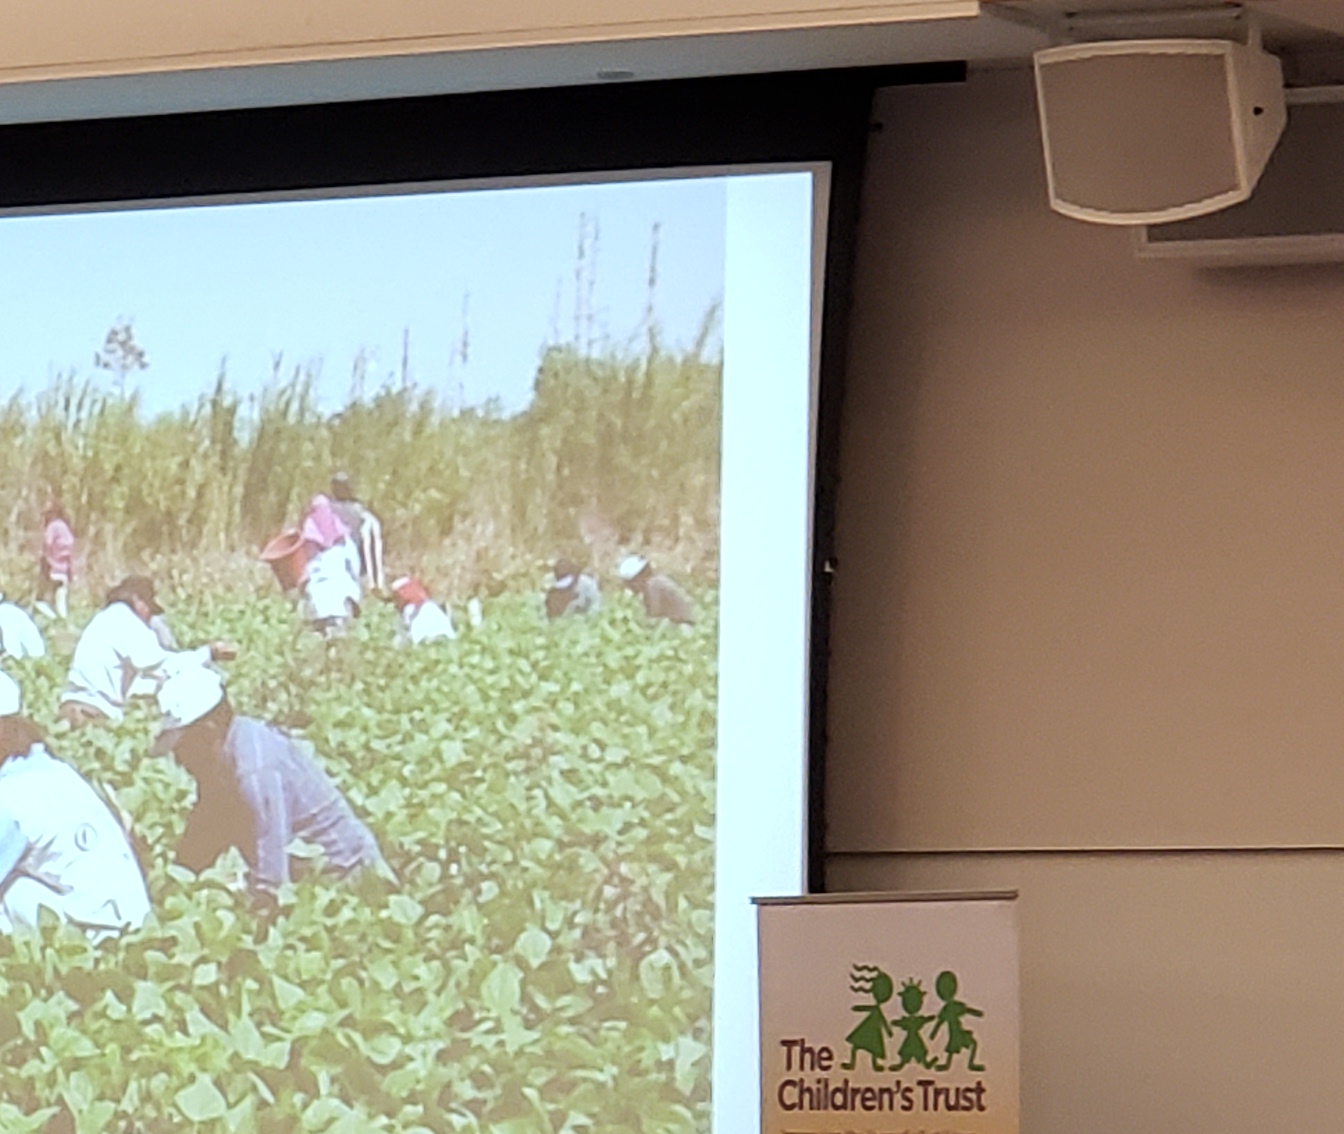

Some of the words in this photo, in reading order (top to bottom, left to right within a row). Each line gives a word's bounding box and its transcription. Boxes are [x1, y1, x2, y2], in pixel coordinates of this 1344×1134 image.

[780, 1038, 834, 1072] The
[777, 1077, 914, 1113] Children's
[916, 1079, 987, 1113] Trust
